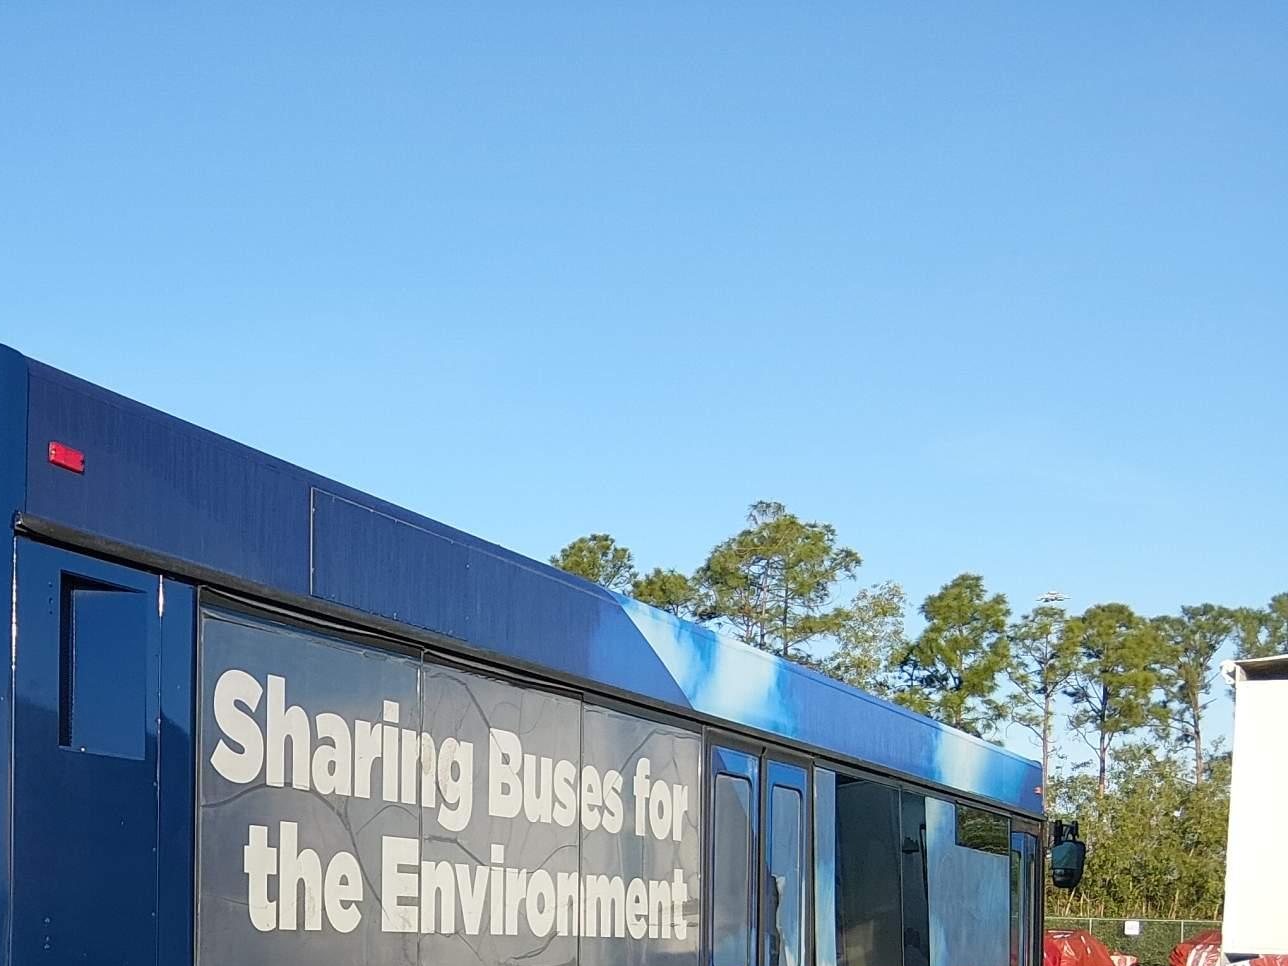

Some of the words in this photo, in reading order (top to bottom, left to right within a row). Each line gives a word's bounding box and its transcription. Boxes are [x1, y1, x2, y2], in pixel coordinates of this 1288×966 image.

[211, 668, 475, 833] Sharing
[488, 726, 624, 835] Buses
[633, 756, 690, 843] for
[243, 820, 365, 932] the
[381, 835, 691, 940] Environment
